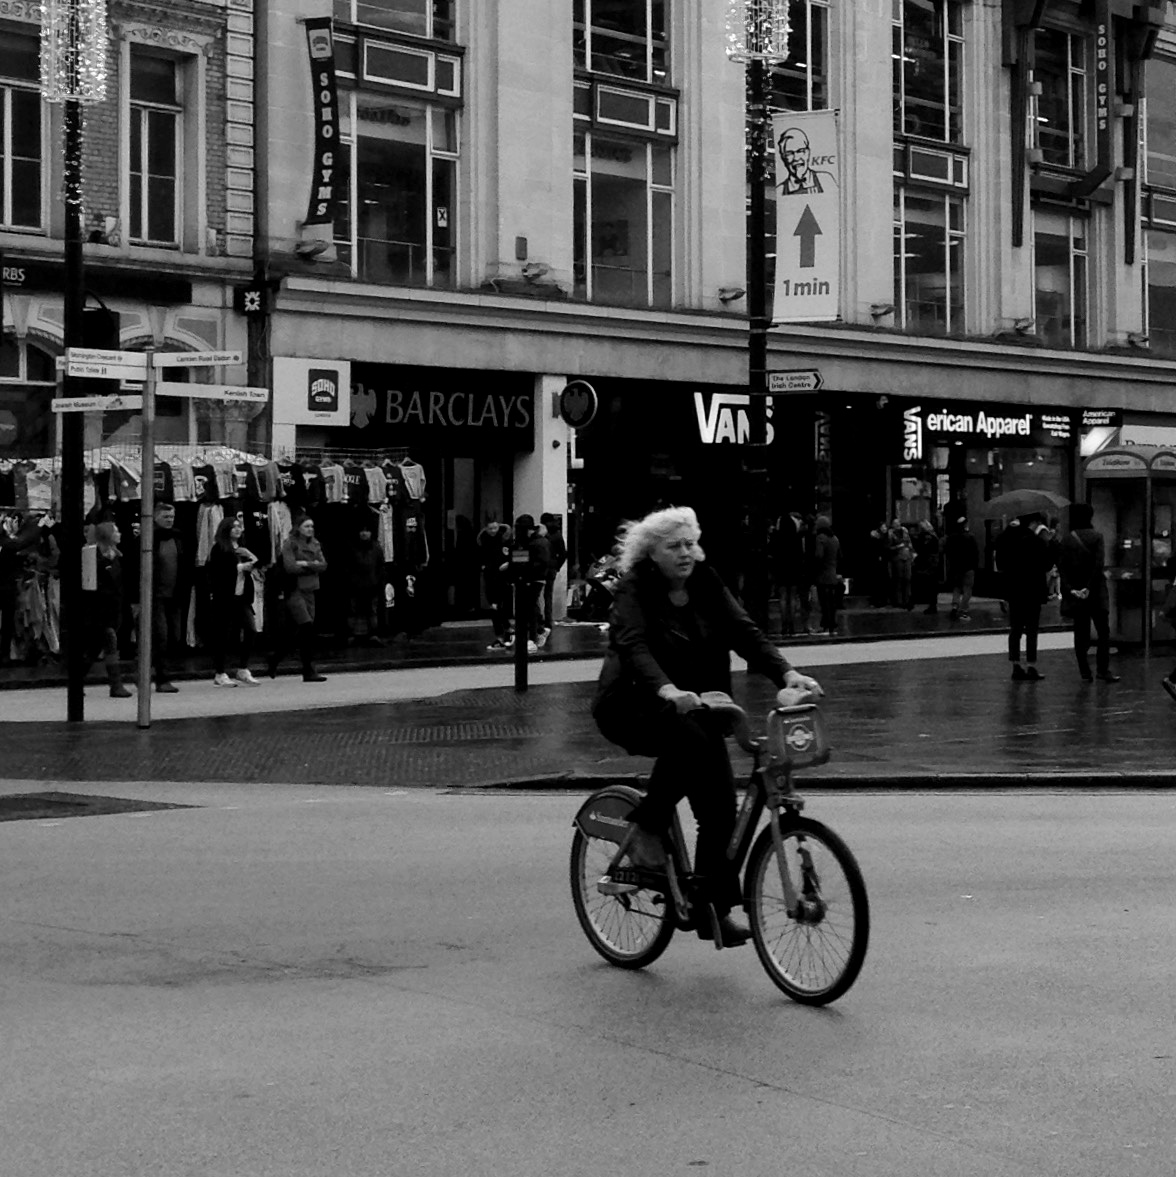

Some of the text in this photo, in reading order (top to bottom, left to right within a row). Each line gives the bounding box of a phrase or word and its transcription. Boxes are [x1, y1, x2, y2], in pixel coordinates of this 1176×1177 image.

[1097, 24, 1108, 131] SOHO GYMS
[316, 72, 333, 216] SOHO GYMS
[811, 155, 836, 167] KFC
[2, 267, 26, 282] RBS
[311, 378, 335, 397] SOHO
[386, 389, 531, 428] BARCLAYS
[975, 411, 1031, 438] Apparel
[903, 406, 922, 462] VANS
